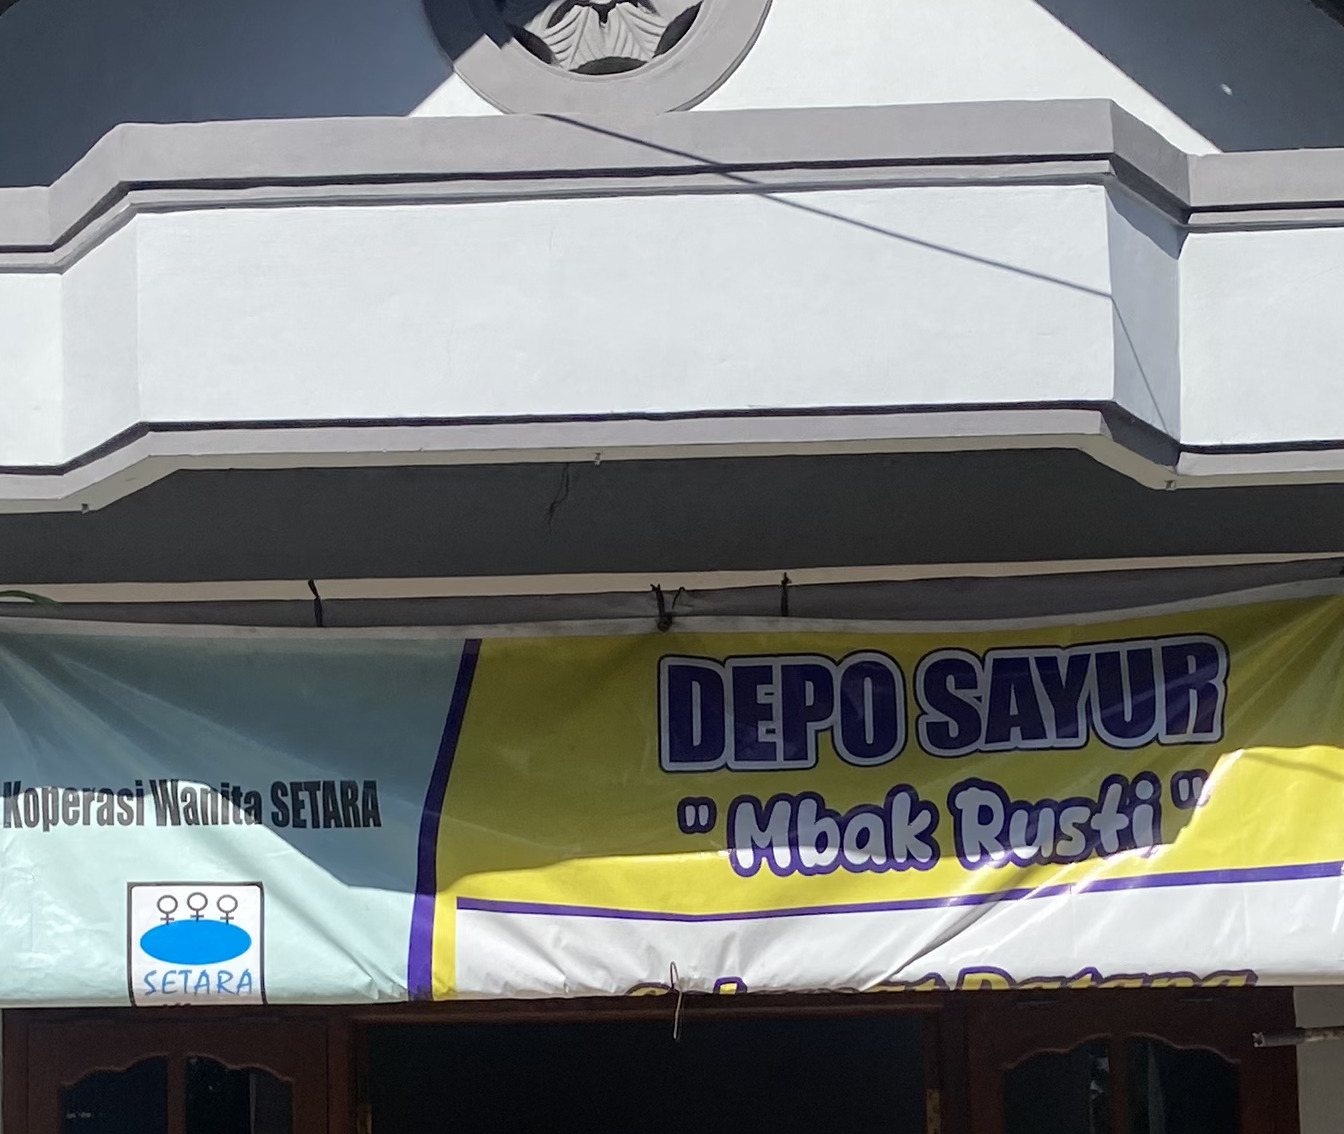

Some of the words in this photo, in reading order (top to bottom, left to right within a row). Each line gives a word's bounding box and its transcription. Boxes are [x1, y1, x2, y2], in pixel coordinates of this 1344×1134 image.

[658, 649, 907, 773] DEPO
[913, 634, 1229, 758] SAYUR
[3, 780, 145, 832] Koperasi
[150, 779, 263, 827] Wanita
[270, 780, 383, 829] SETARA
[143, 968, 253, 997] SETARA
